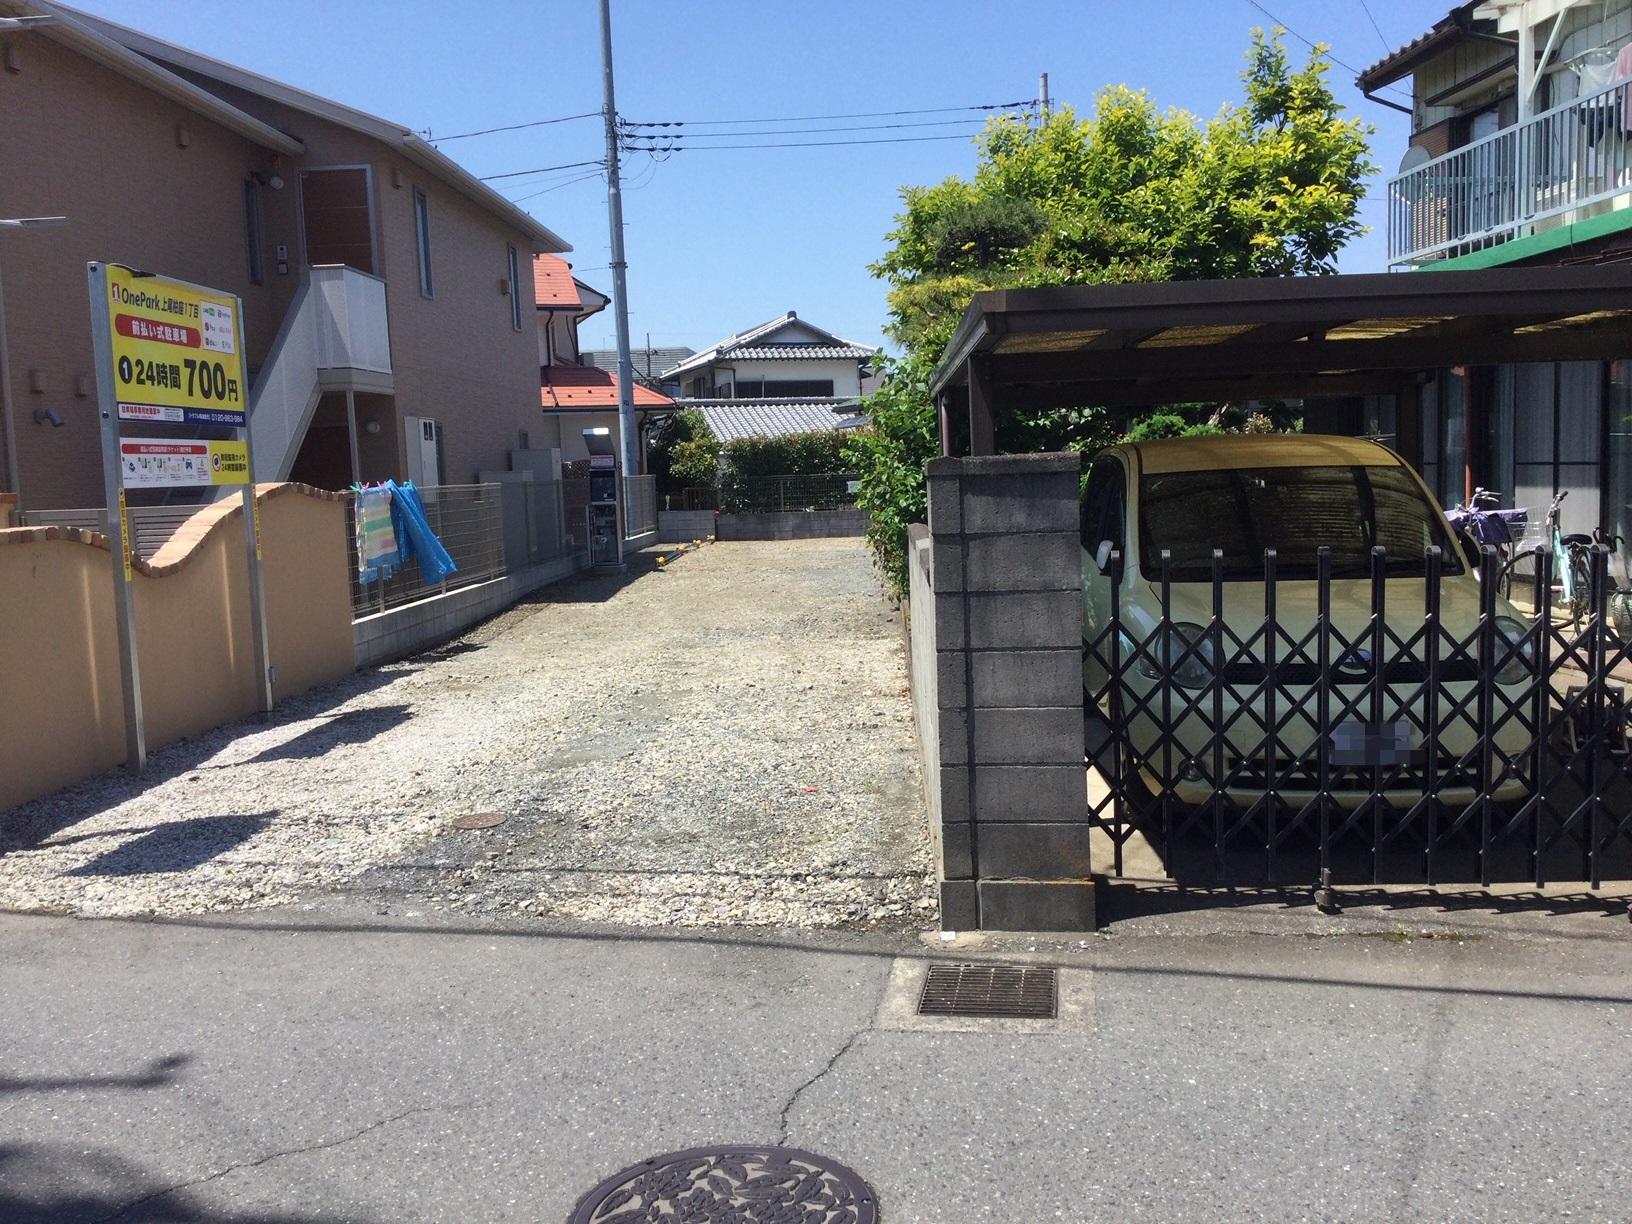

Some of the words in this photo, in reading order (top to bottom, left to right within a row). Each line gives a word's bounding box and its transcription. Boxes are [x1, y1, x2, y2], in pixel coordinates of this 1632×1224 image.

[121, 287, 160, 311] OnePark
[131, 319, 188, 344] 前払い式駐車場
[135, 358, 181, 390] 24時間
[183, 358, 238, 402] 700円
